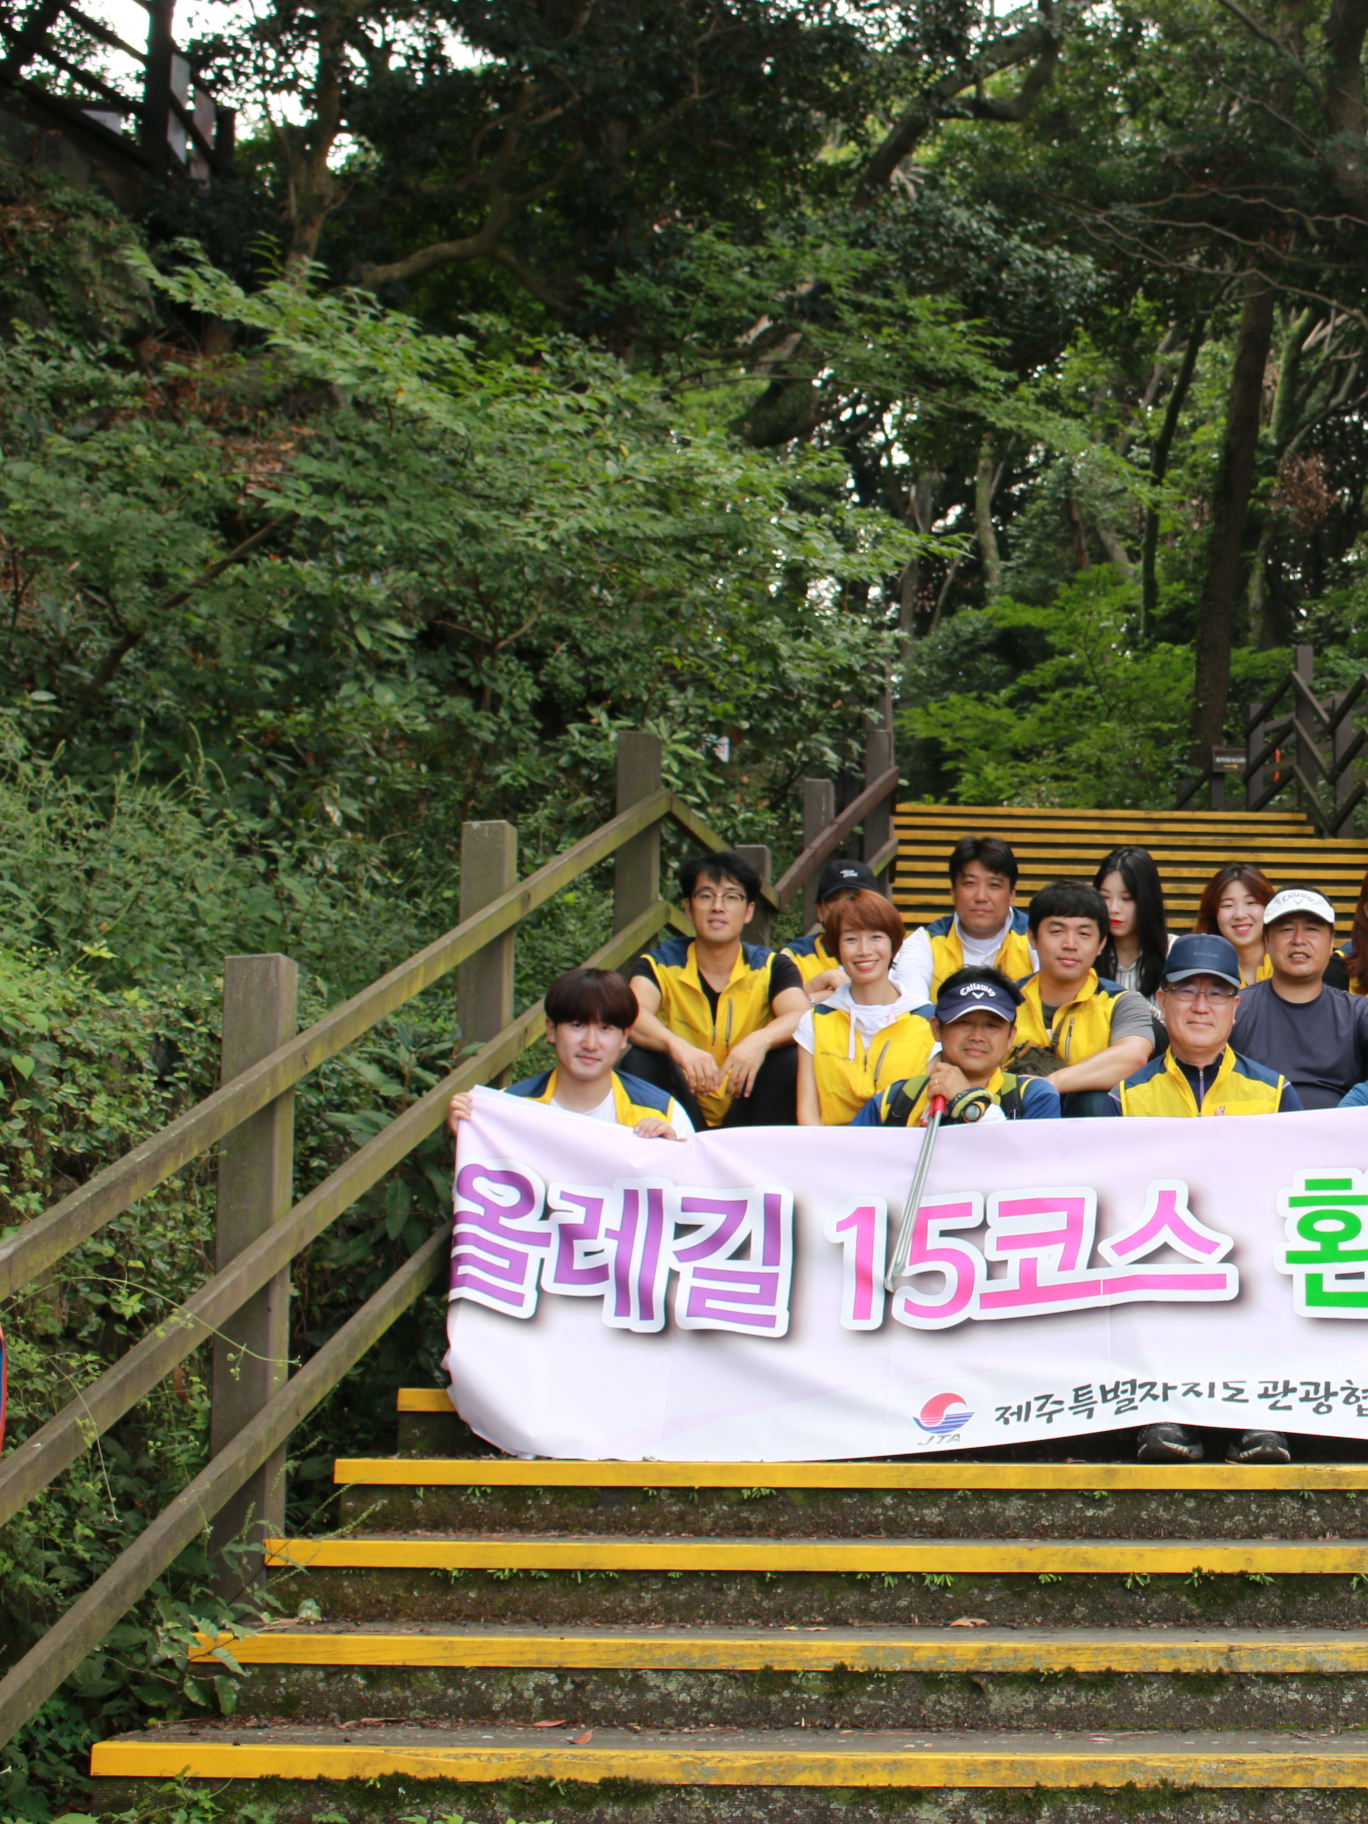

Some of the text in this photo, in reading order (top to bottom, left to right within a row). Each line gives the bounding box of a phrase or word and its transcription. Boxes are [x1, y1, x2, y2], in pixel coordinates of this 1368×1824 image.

[960, 983, 996, 997] Callaway
[450, 1162, 784, 1329] 올레길
[836, 1188, 1229, 1321] 15코스
[917, 1433, 961, 1446] JTA
